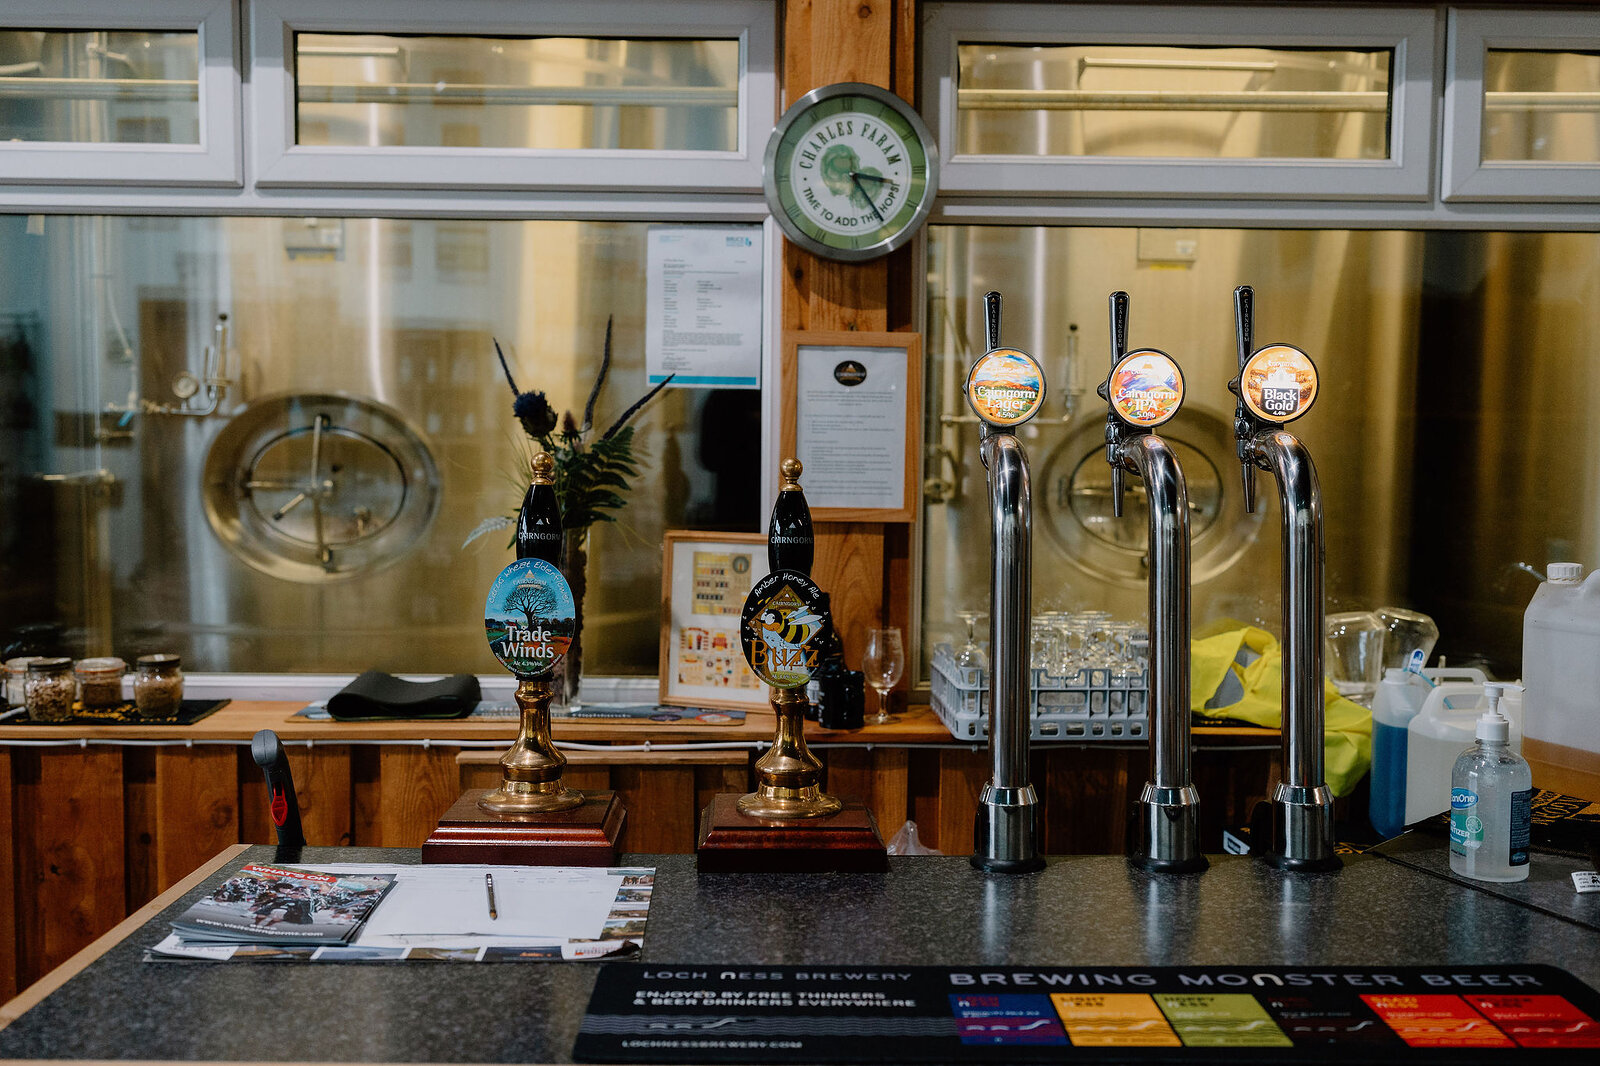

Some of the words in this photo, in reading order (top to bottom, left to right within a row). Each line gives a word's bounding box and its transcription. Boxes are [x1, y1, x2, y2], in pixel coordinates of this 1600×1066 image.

[799, 121, 853, 169] CHARLES
[861, 123, 902, 165] FARAM
[803, 187, 821, 211] TIME
[820, 208, 834, 221] TO
[834, 216, 858, 227] ADD
[977, 386, 1036, 400] Cairngorm
[1118, 388, 1176, 400] Cairngorm
[1264, 389, 1297, 401] Black
[987, 398, 1027, 411] Lager
[1135, 399, 1158, 411] IPA
[1265, 400, 1294, 411] Gold
[754, 575, 779, 597] Amber
[783, 572, 808, 587] Honey
[808, 586, 820, 600] Ale
[505, 626, 552, 642] Trade
[500, 642, 555, 658] Winds
[643, 971, 708, 980] LOCH
[796, 972, 912, 982] BREWERY
[949, 972, 1158, 987] BREWING
[1178, 972, 1405, 988] MONSTER
[1420, 974, 1544, 988] BEER
[635, 991, 716, 999] ENJOYED
[797, 992, 886, 1000] THINKERS
[652, 998, 698, 1006] BEER
[799, 999, 917, 1007] EVERYWHERE
